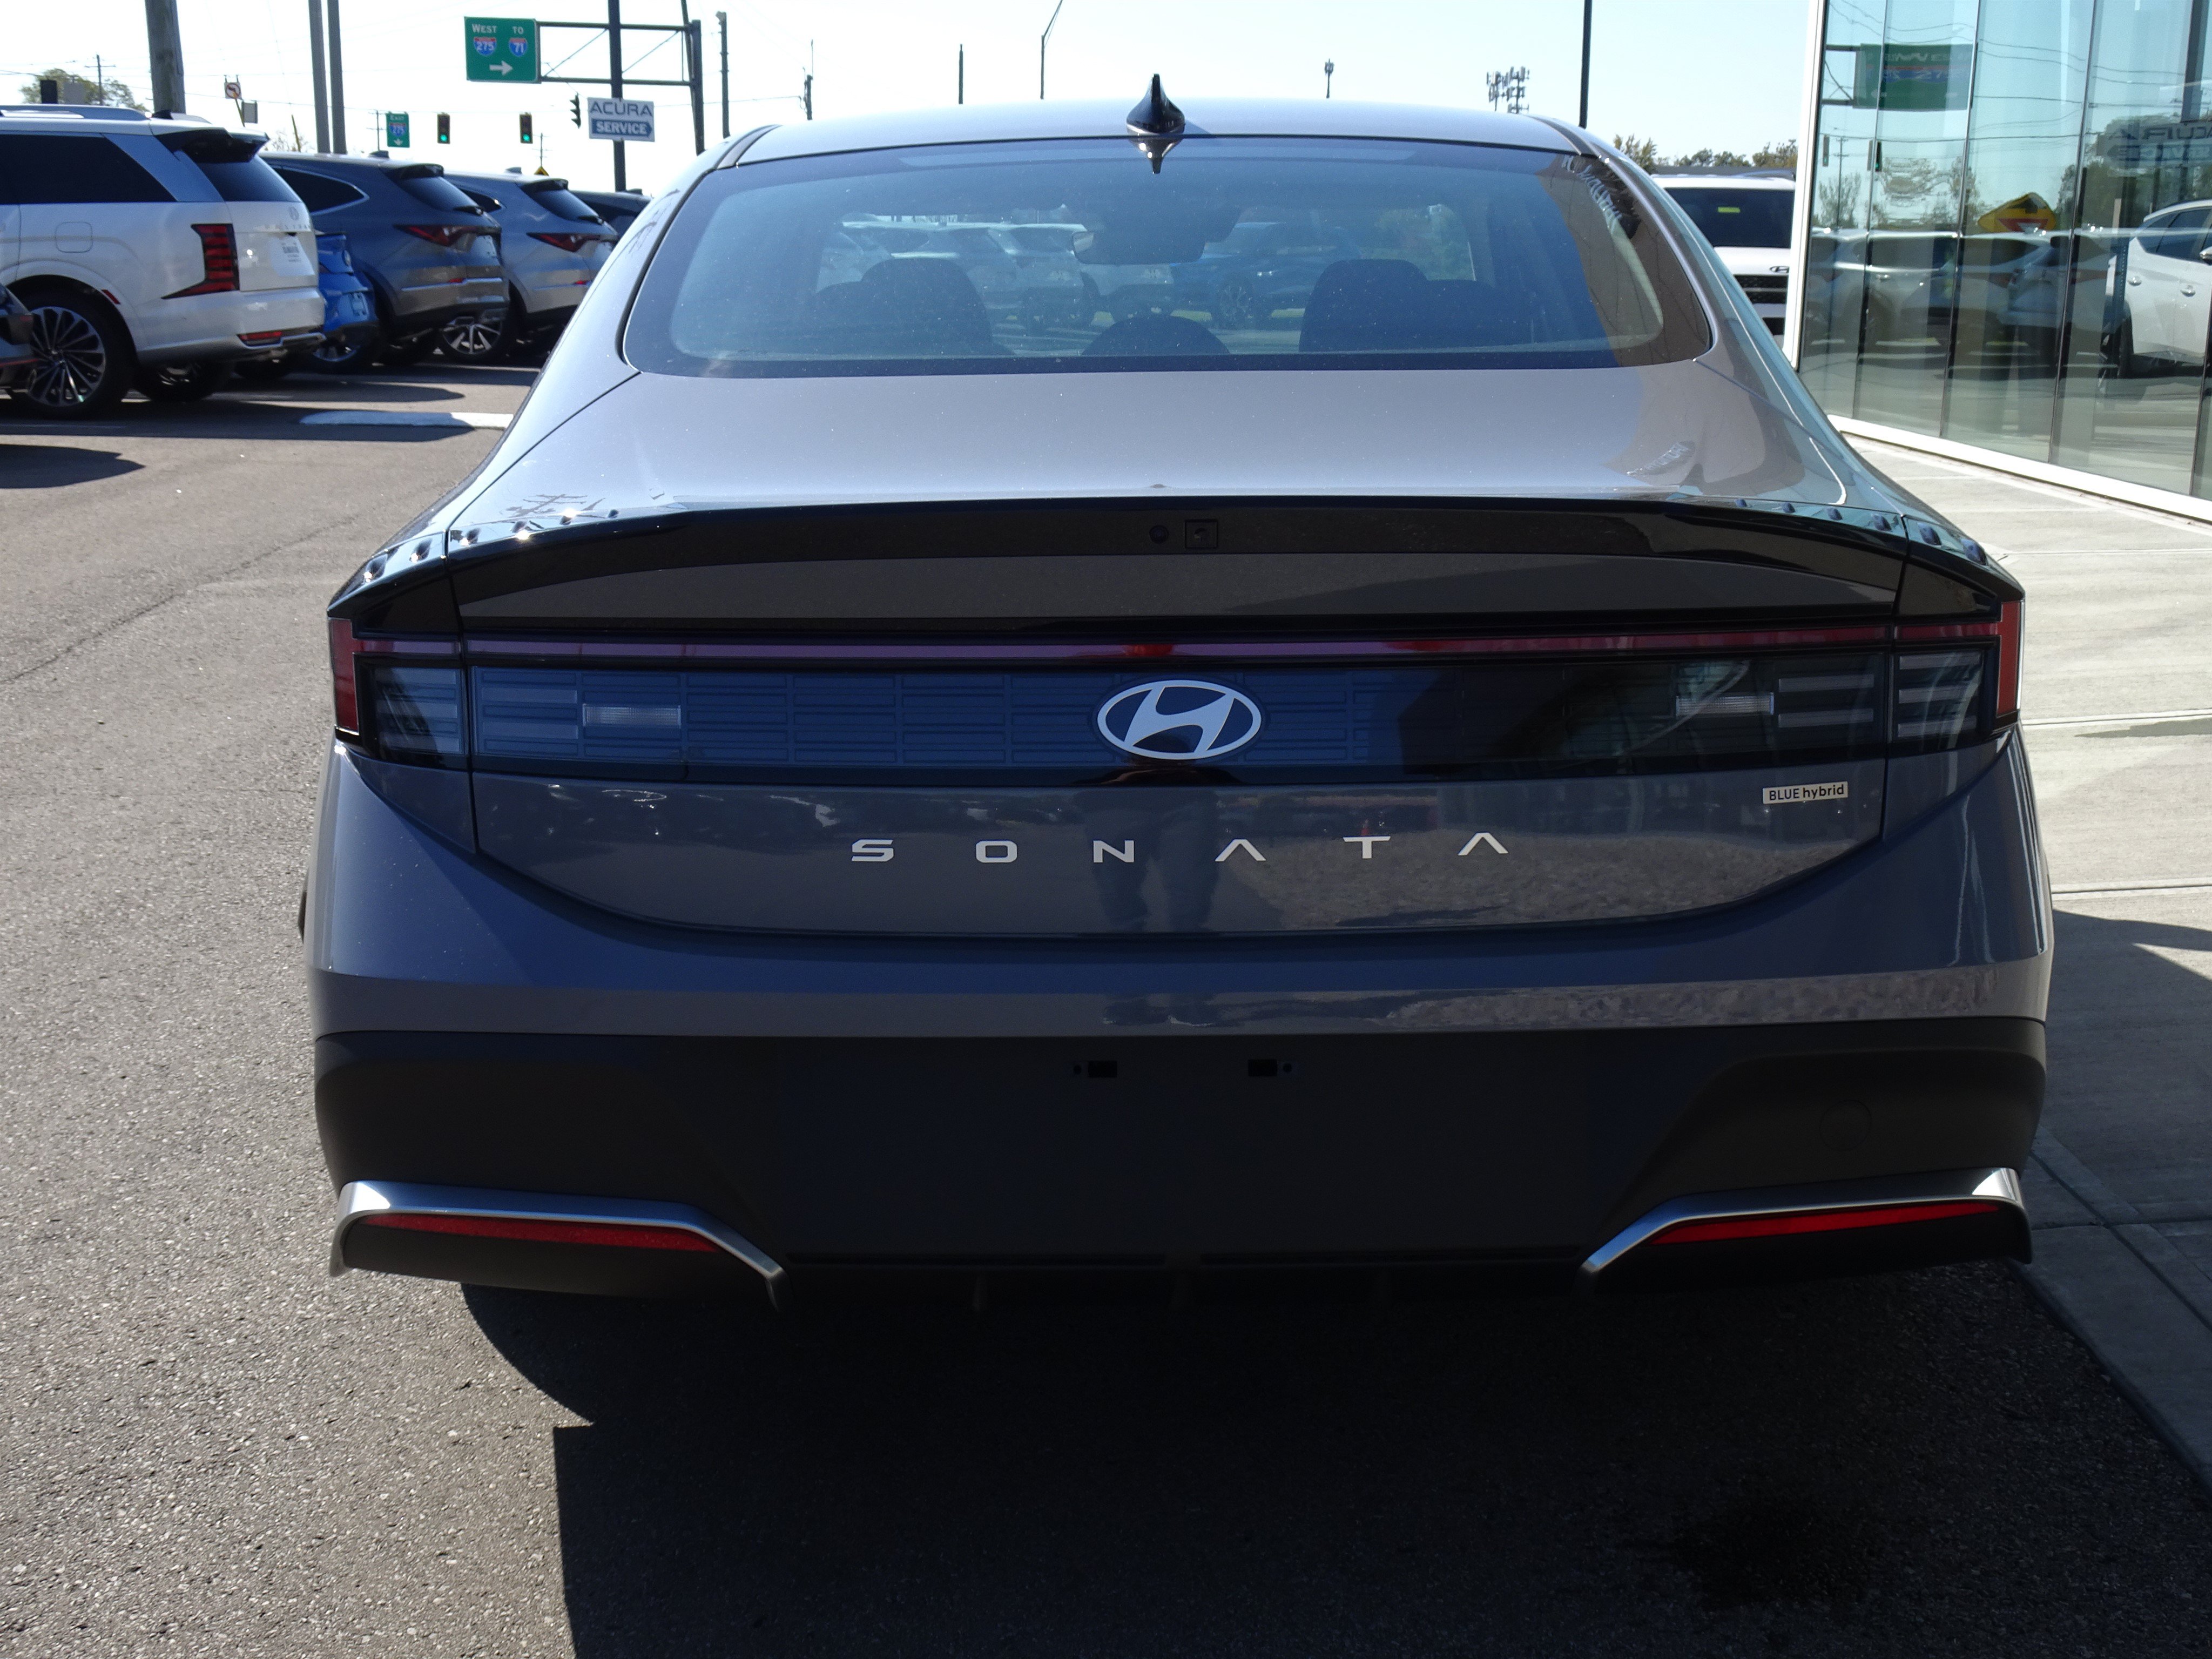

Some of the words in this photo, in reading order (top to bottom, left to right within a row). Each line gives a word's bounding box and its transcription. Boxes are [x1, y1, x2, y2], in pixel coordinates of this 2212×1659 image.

[472, 23, 497, 33] WEST
[512, 26, 524, 35] TO
[476, 41, 494, 51] 275
[514, 43, 524, 53] 71
[590, 101, 653, 117] ACURA
[596, 120, 647, 134] SERVICE
[1769, 788, 1799, 800] BLUE
[1803, 784, 1844, 799] hybrid
[851, 832, 1508, 863] SONATA
